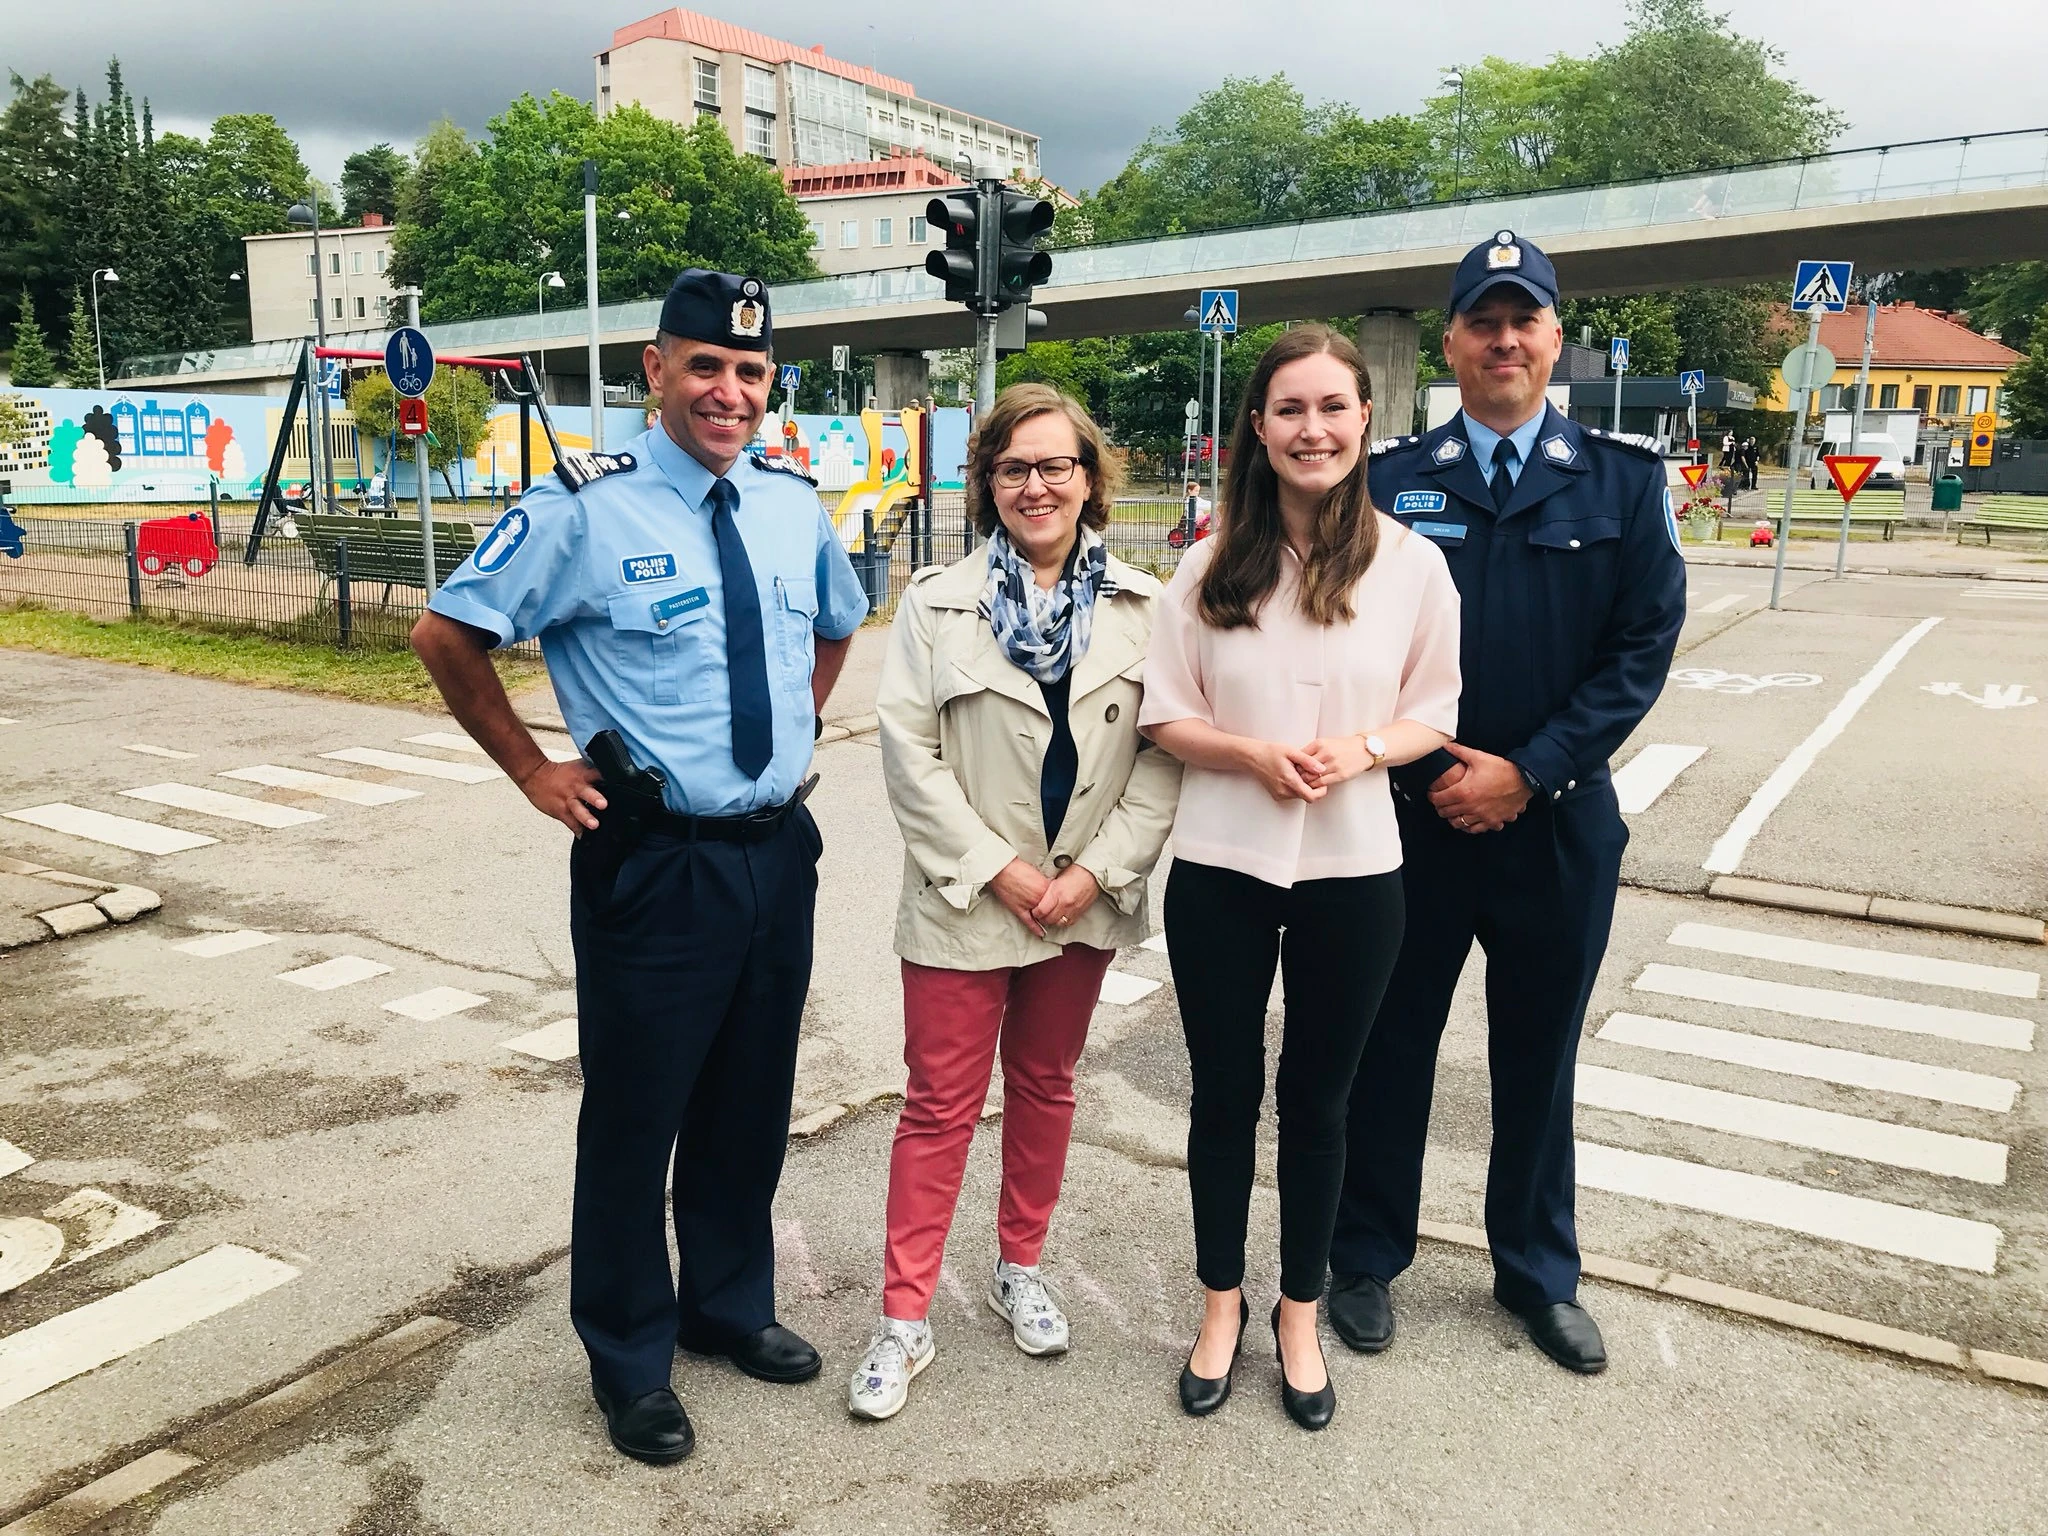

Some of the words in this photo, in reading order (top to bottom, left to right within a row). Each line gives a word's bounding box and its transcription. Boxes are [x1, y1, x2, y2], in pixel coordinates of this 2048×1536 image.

[406, 403, 418, 423] 4
[629, 557, 668, 571] POLIISI
[635, 567, 667, 579] POLIS
